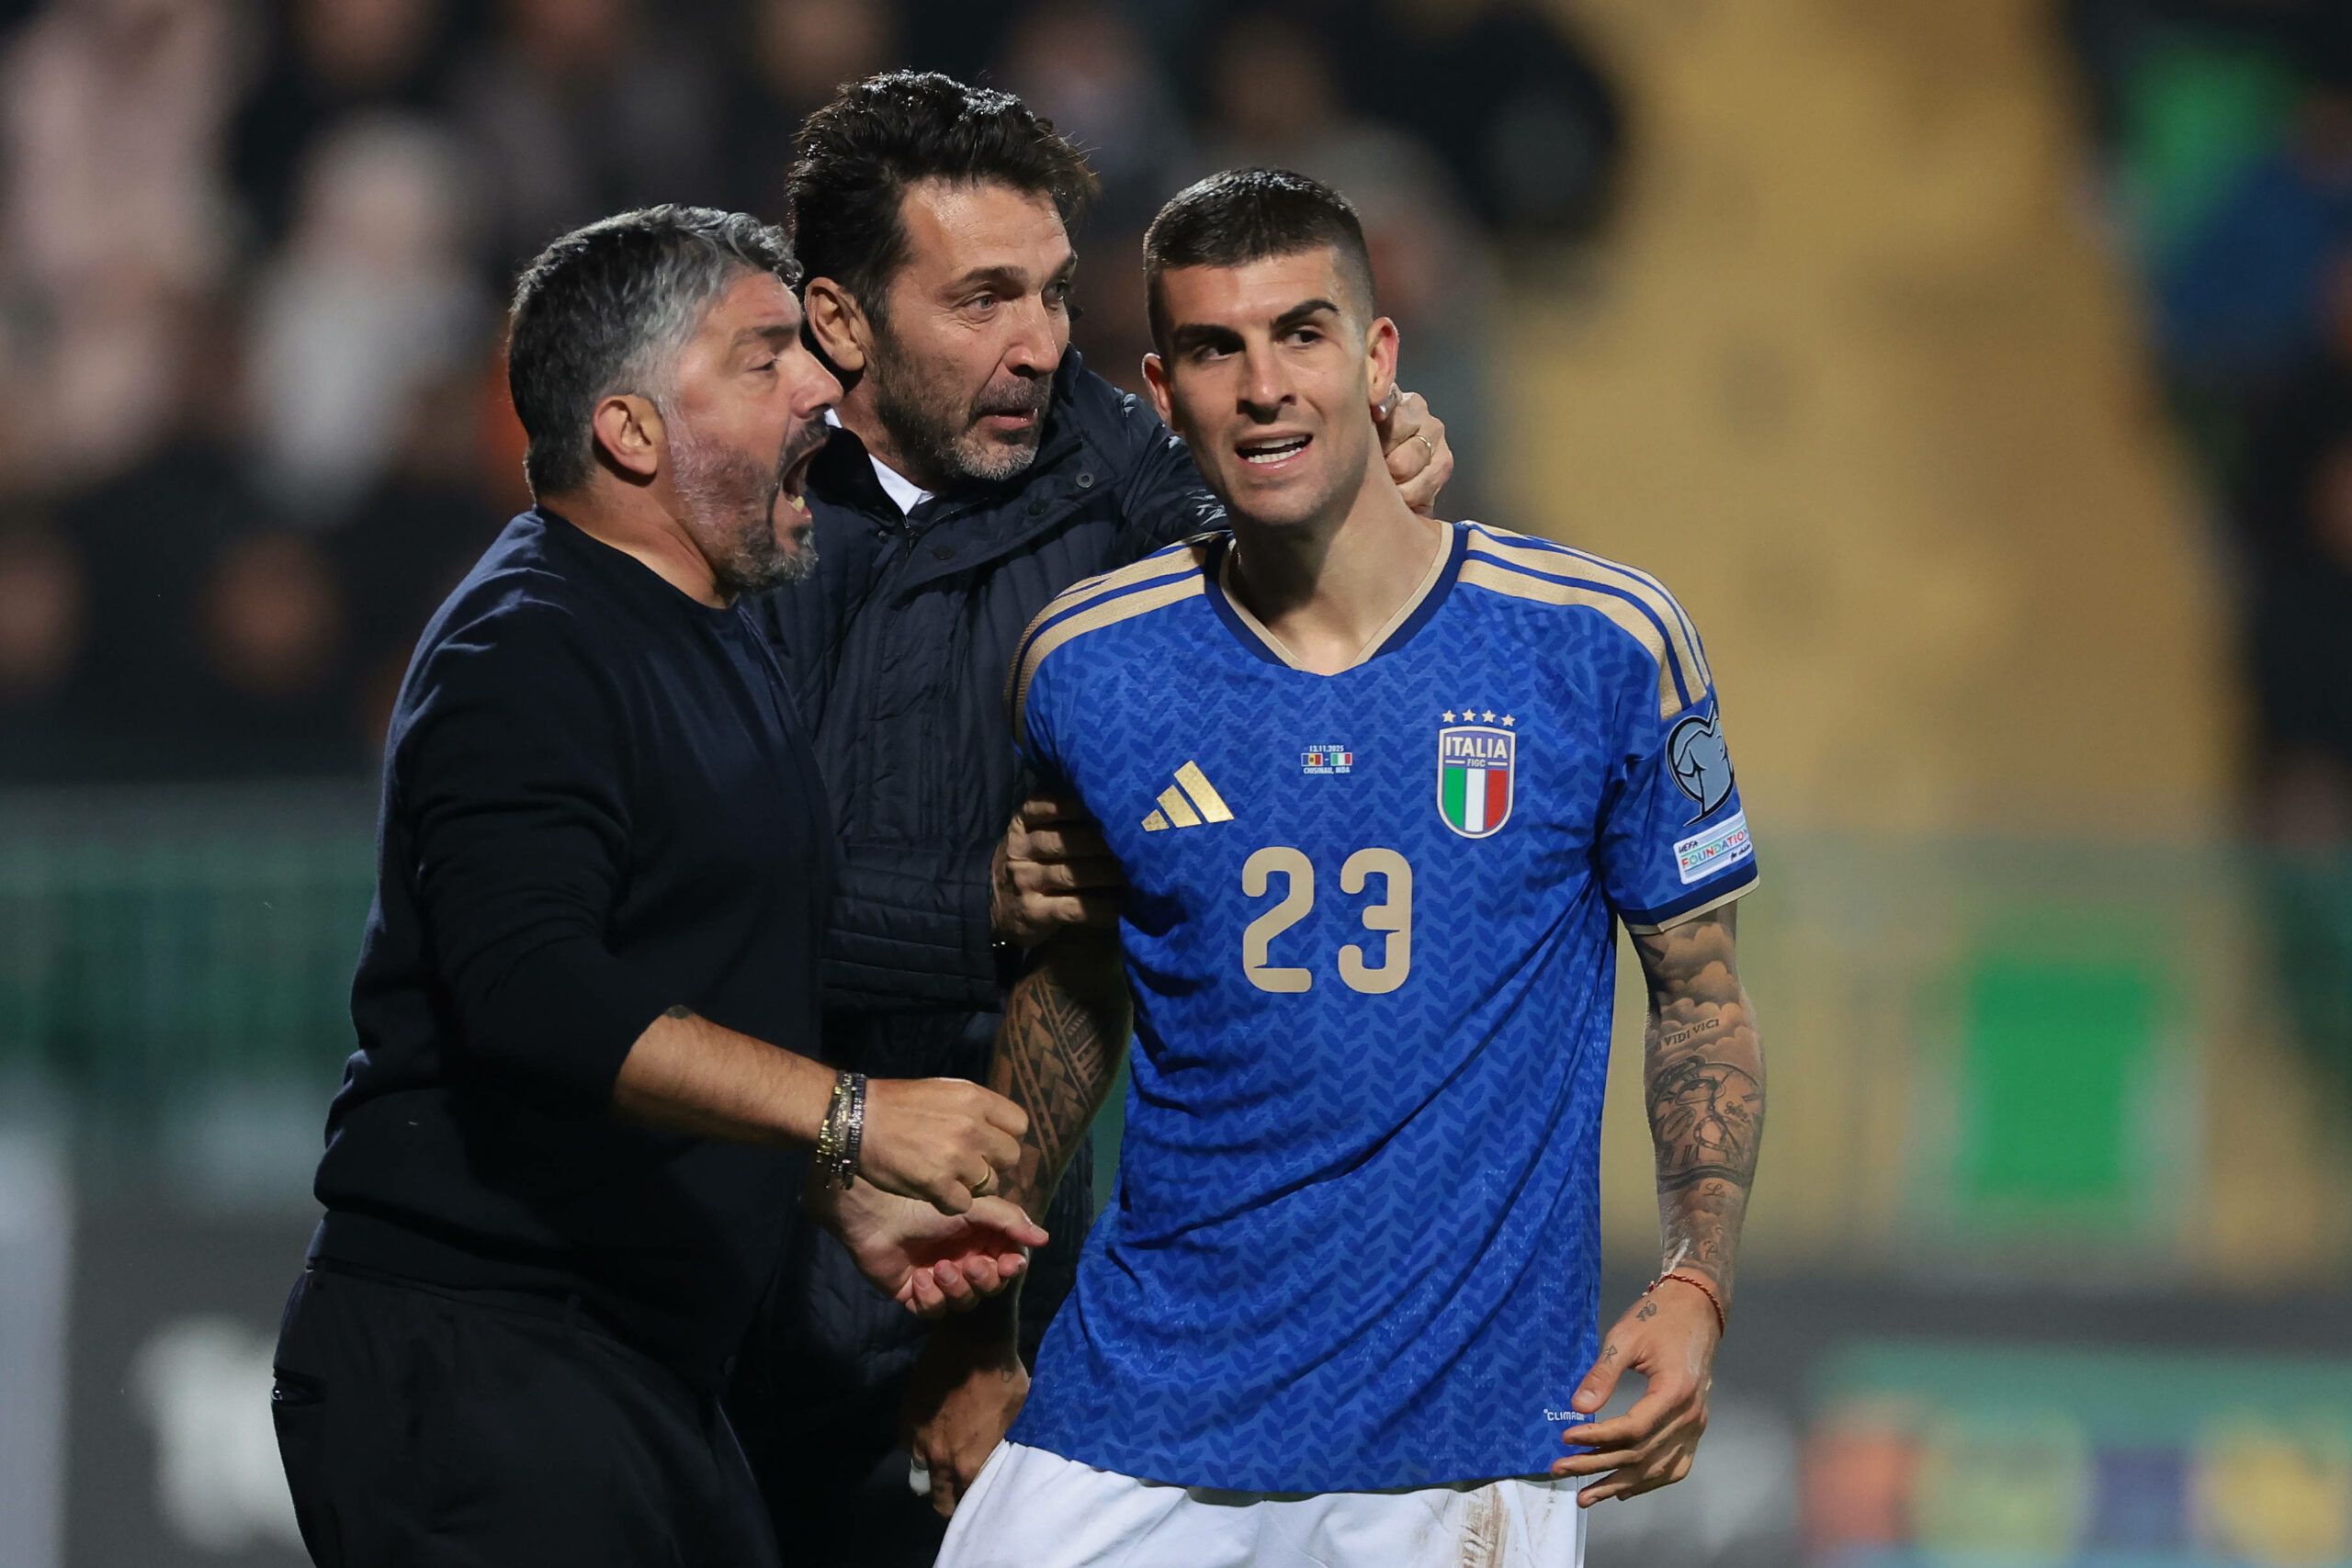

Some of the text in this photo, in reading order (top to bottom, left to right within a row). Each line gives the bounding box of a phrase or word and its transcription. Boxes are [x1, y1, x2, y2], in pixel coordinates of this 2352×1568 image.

[1445, 737, 1508, 759] ITALIA
[1466, 759, 1486, 768] FIGC
[1679, 840, 1698, 853] UEFA
[1241, 846, 1413, 995] 23
[1664, 1029, 1690, 1045] VIDI
[1693, 1019, 1720, 1033] VICI
